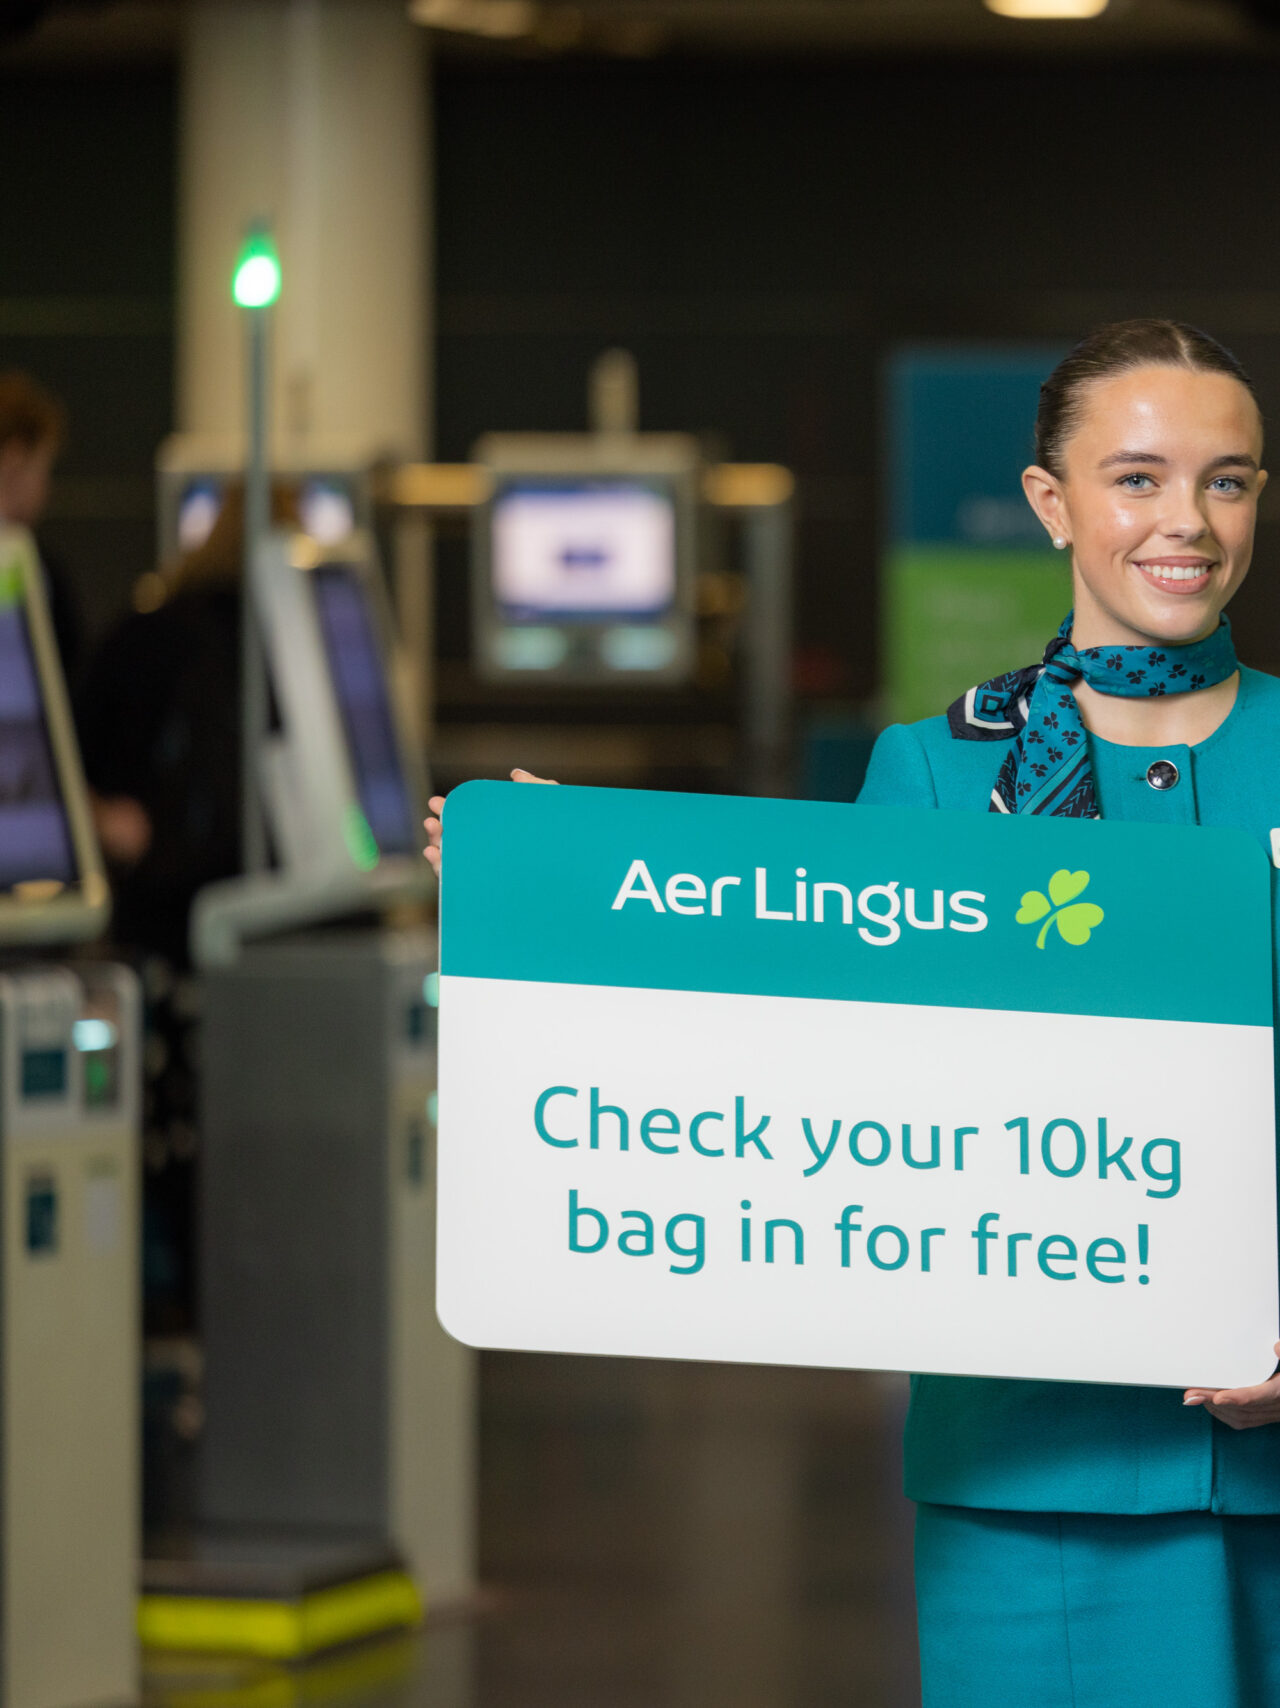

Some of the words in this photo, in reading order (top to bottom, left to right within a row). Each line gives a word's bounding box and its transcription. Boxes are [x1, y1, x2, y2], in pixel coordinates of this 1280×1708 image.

[611, 860, 741, 916] Aer
[756, 867, 988, 946] Lingus
[535, 1086, 772, 1159] Check
[802, 1118, 978, 1176] your
[1005, 1117, 1180, 1198] 10kg
[569, 1190, 704, 1274] bag
[741, 1200, 803, 1264] in
[835, 1205, 945, 1272] for
[972, 1213, 1149, 1284] free!
